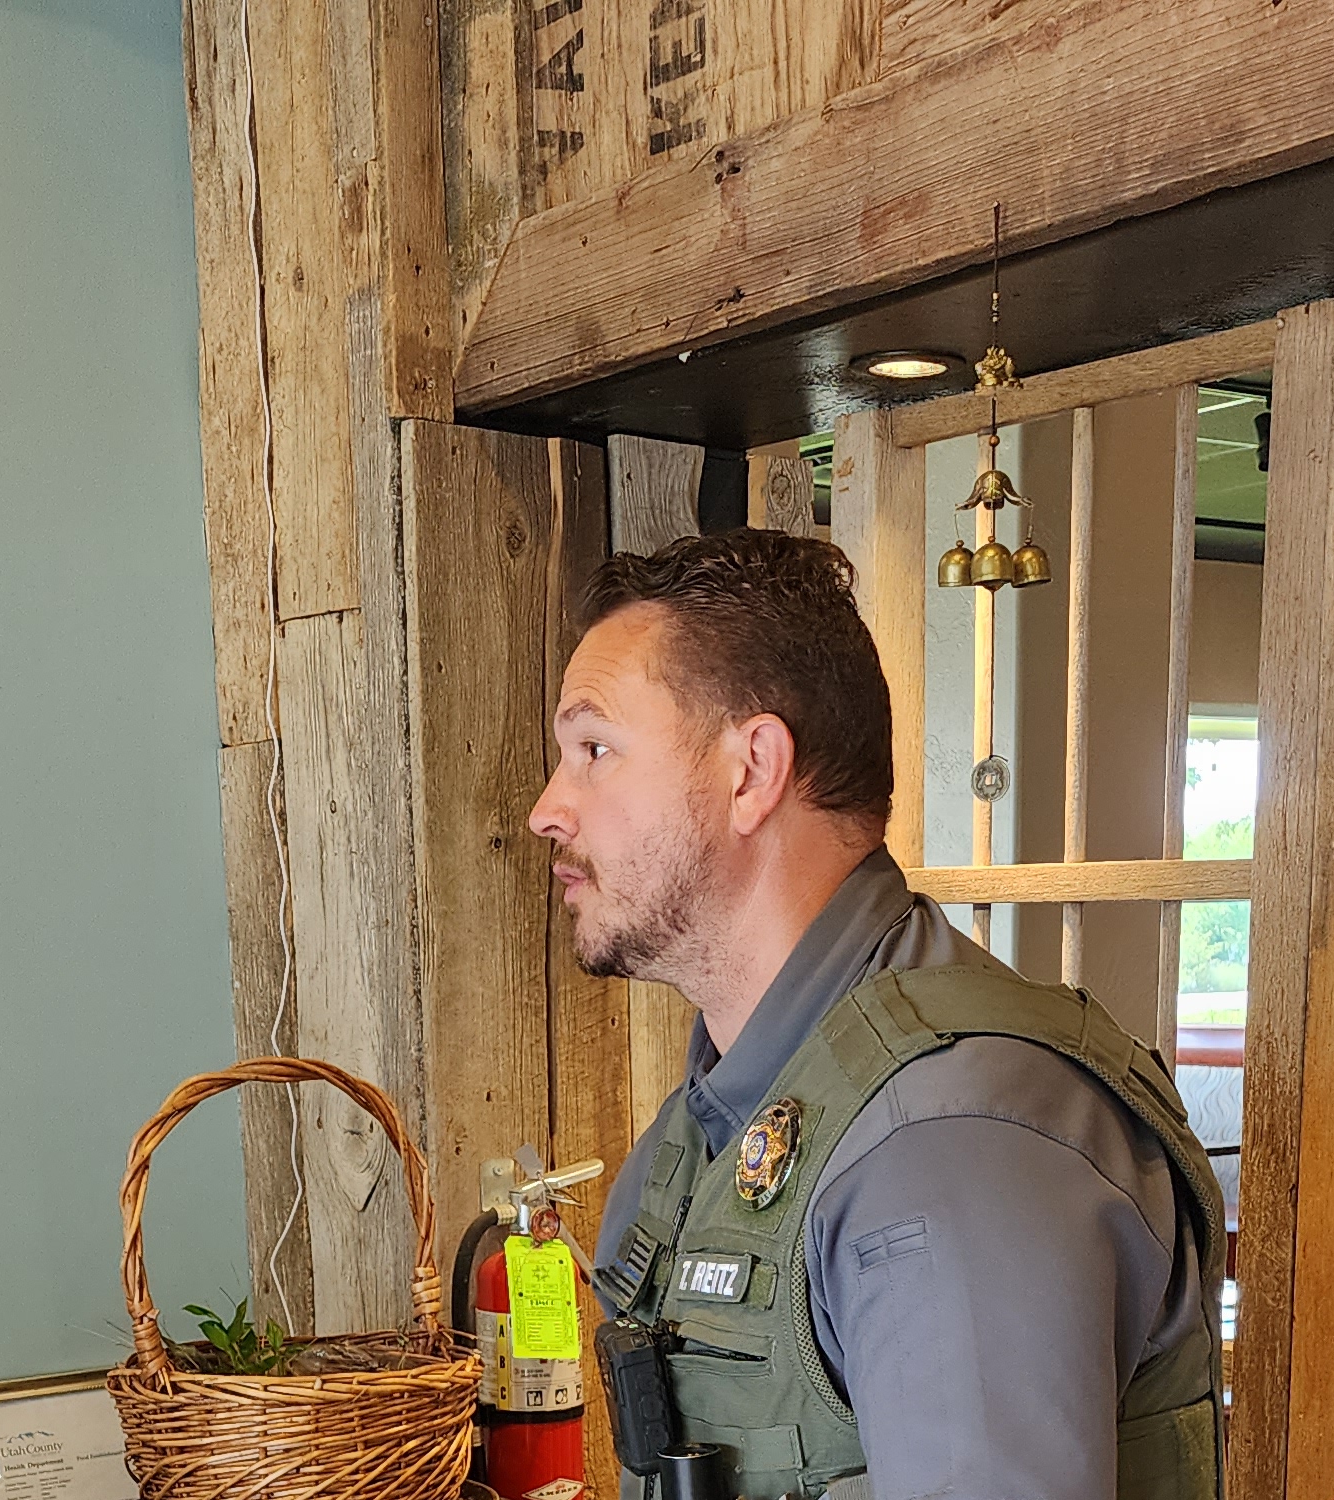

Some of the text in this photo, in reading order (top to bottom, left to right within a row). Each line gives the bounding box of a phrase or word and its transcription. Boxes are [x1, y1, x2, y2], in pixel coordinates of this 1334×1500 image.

[689, 1261, 740, 1297] REITZ
[498, 1324, 506, 1338] A
[499, 1355, 506, 1369] B
[500, 1386, 507, 1400] C
